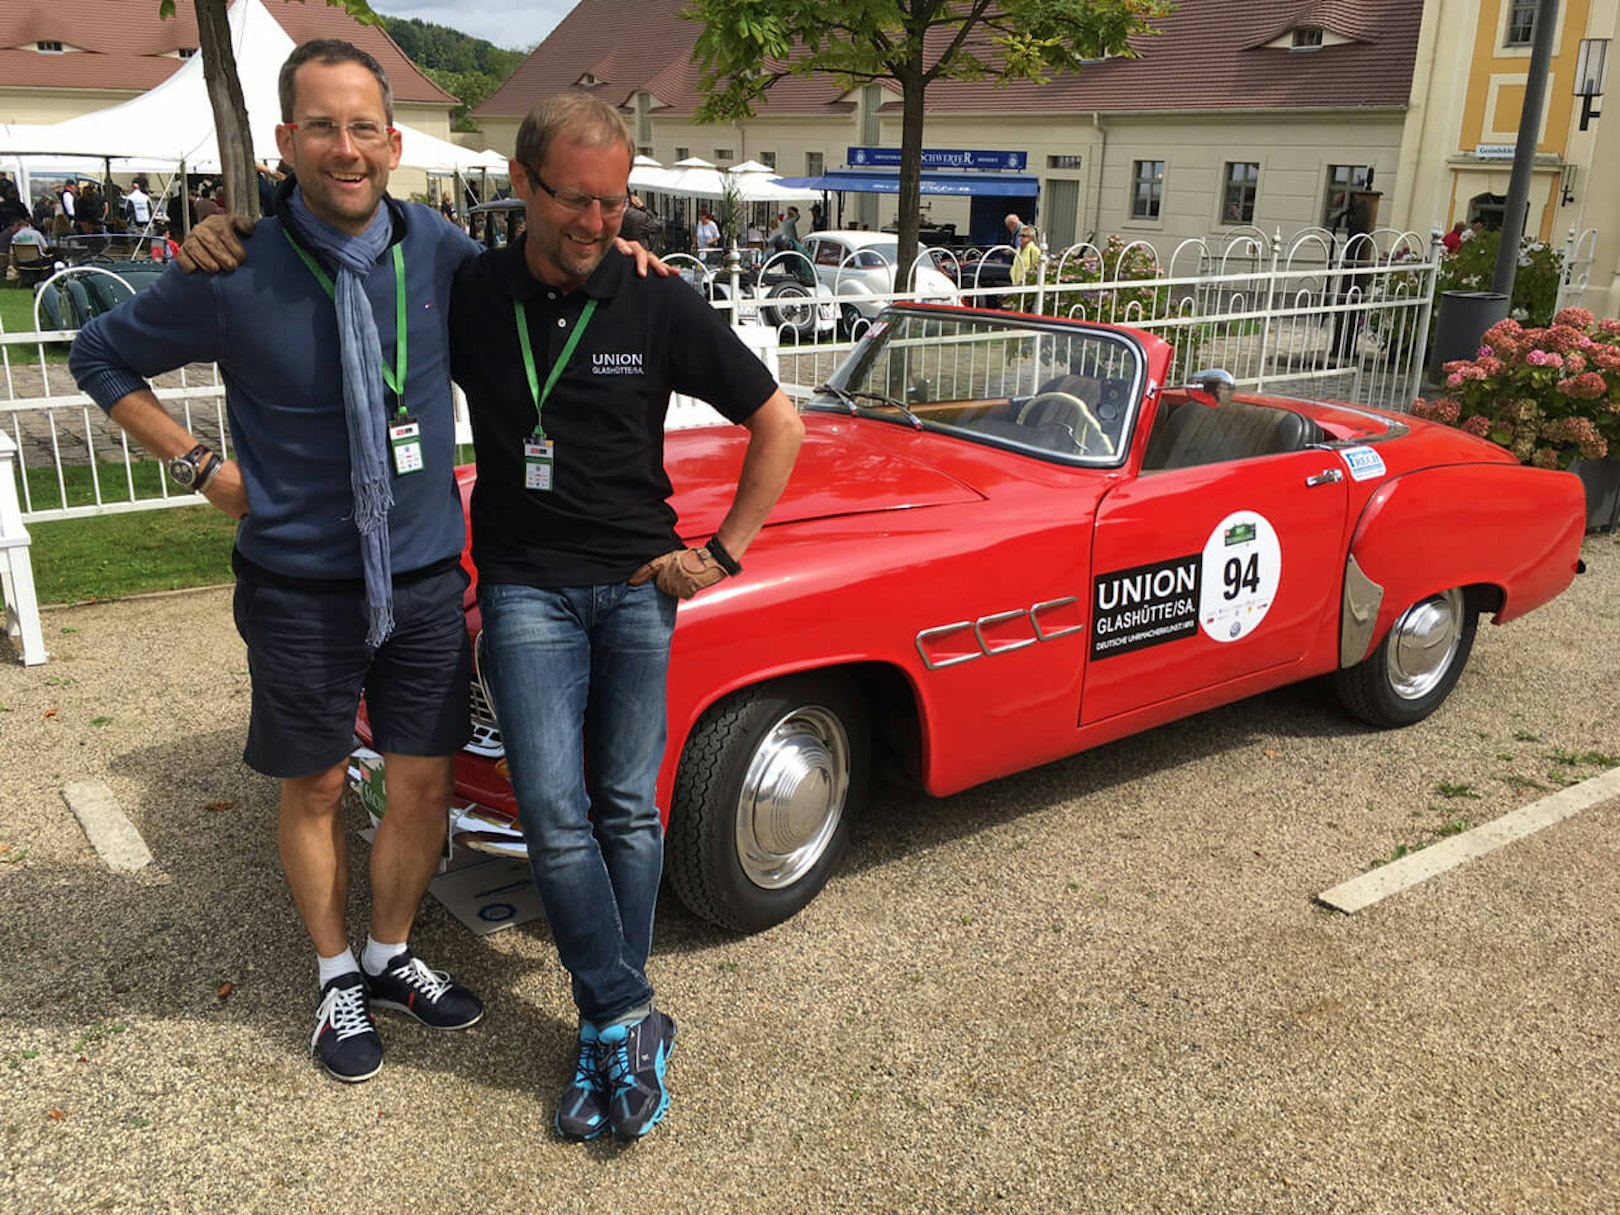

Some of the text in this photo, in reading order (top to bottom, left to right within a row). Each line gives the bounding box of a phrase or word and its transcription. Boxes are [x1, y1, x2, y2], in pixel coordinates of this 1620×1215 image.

[592, 353, 643, 366] UNION
[1098, 564, 1197, 610] UNION
[1223, 552, 1260, 601] 94
[1096, 597, 1196, 635] GLASHÜTTE/SA.
[1095, 635, 1128, 651] DEUTSCHE
